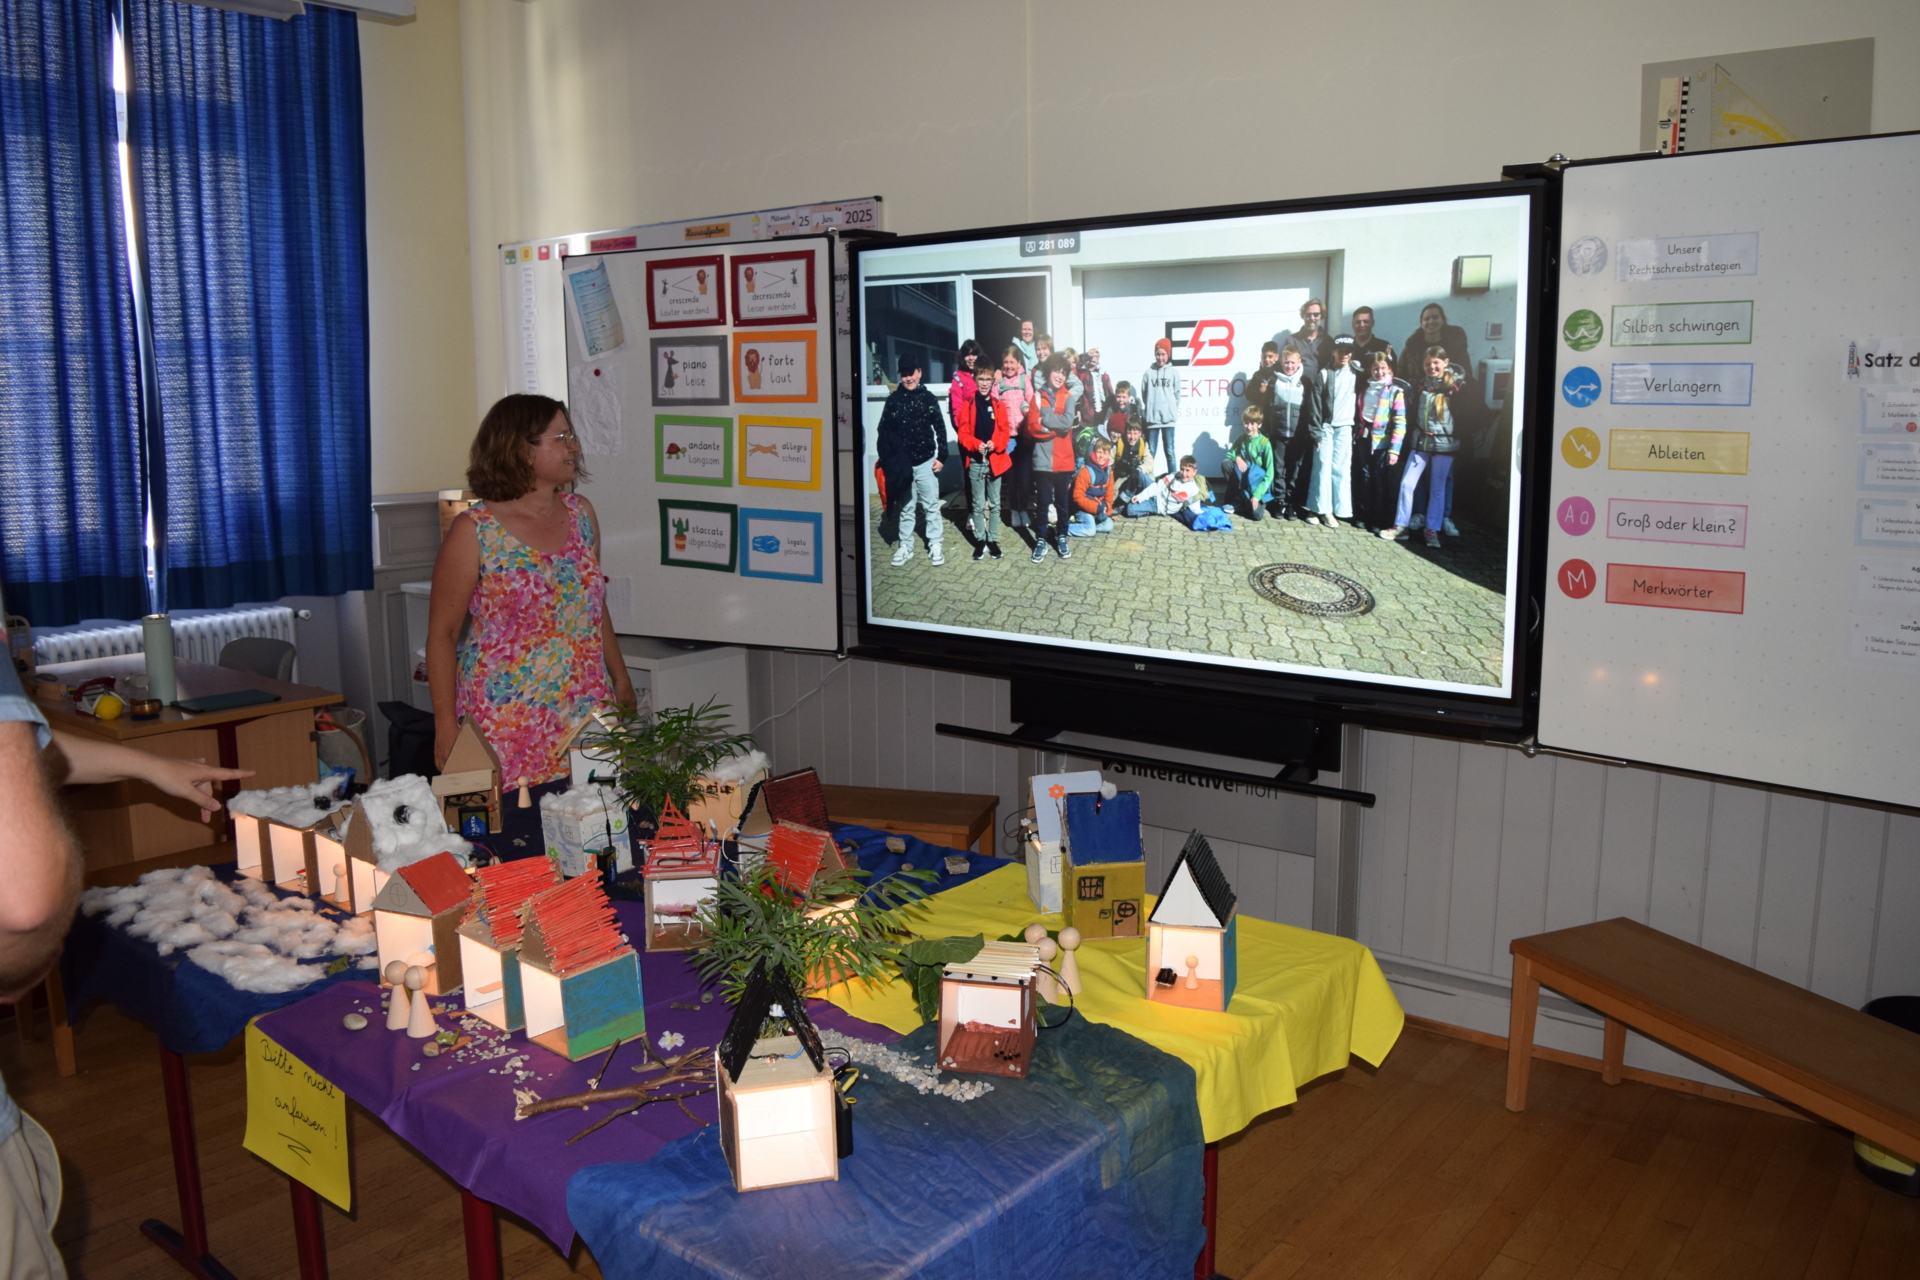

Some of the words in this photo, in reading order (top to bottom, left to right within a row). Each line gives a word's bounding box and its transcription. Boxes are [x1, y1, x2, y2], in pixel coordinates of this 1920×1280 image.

[799, 216, 810, 227] 25
[821, 214, 834, 225] Juni
[845, 209, 873, 224] 2025
[1039, 240, 1055, 250] 281
[1057, 238, 1075, 249] 089
[1667, 244, 1702, 255] Unsere
[1629, 262, 1741, 276] Rechtschreibstrategien
[669, 297, 699, 305] crescendo
[752, 291, 791, 301] decrescendo
[660, 308, 680, 317] lauter
[682, 307, 710, 316] werdend
[747, 304, 765, 313] leiser
[767, 302, 796, 312] werdend
[838, 327, 850, 335] Pau
[1621, 318, 1664, 334] Silben
[1669, 317, 1740, 336] schwingen
[682, 360, 707, 372] piano
[768, 354, 794, 366] forte
[1864, 352, 1903, 368] Satz
[685, 375, 706, 386] leise
[770, 372, 792, 384] laut
[1644, 377, 1722, 397] Verlängern
[841, 392, 852, 400] Pau
[688, 441, 720, 451] andante
[781, 442, 808, 453] allegro
[1648, 444, 1705, 460] Ableiten
[688, 455, 720, 467] langsam
[781, 454, 807, 463] schnell
[1616, 512, 1650, 532] Groß
[1655, 516, 1688, 531] oder
[1692, 517, 1736, 534] klein?
[692, 526, 724, 537] staccato
[688, 535, 727, 550] abgestoßen
[787, 538, 806, 547] legato
[784, 546, 810, 557] gebunden
[1567, 568, 1587, 591] M
[1633, 579, 1714, 599] Merkwörter
[260, 1039, 293, 1076] Bitte
[303, 1071, 335, 1099] nicht
[275, 1097, 327, 1137] anfassen
